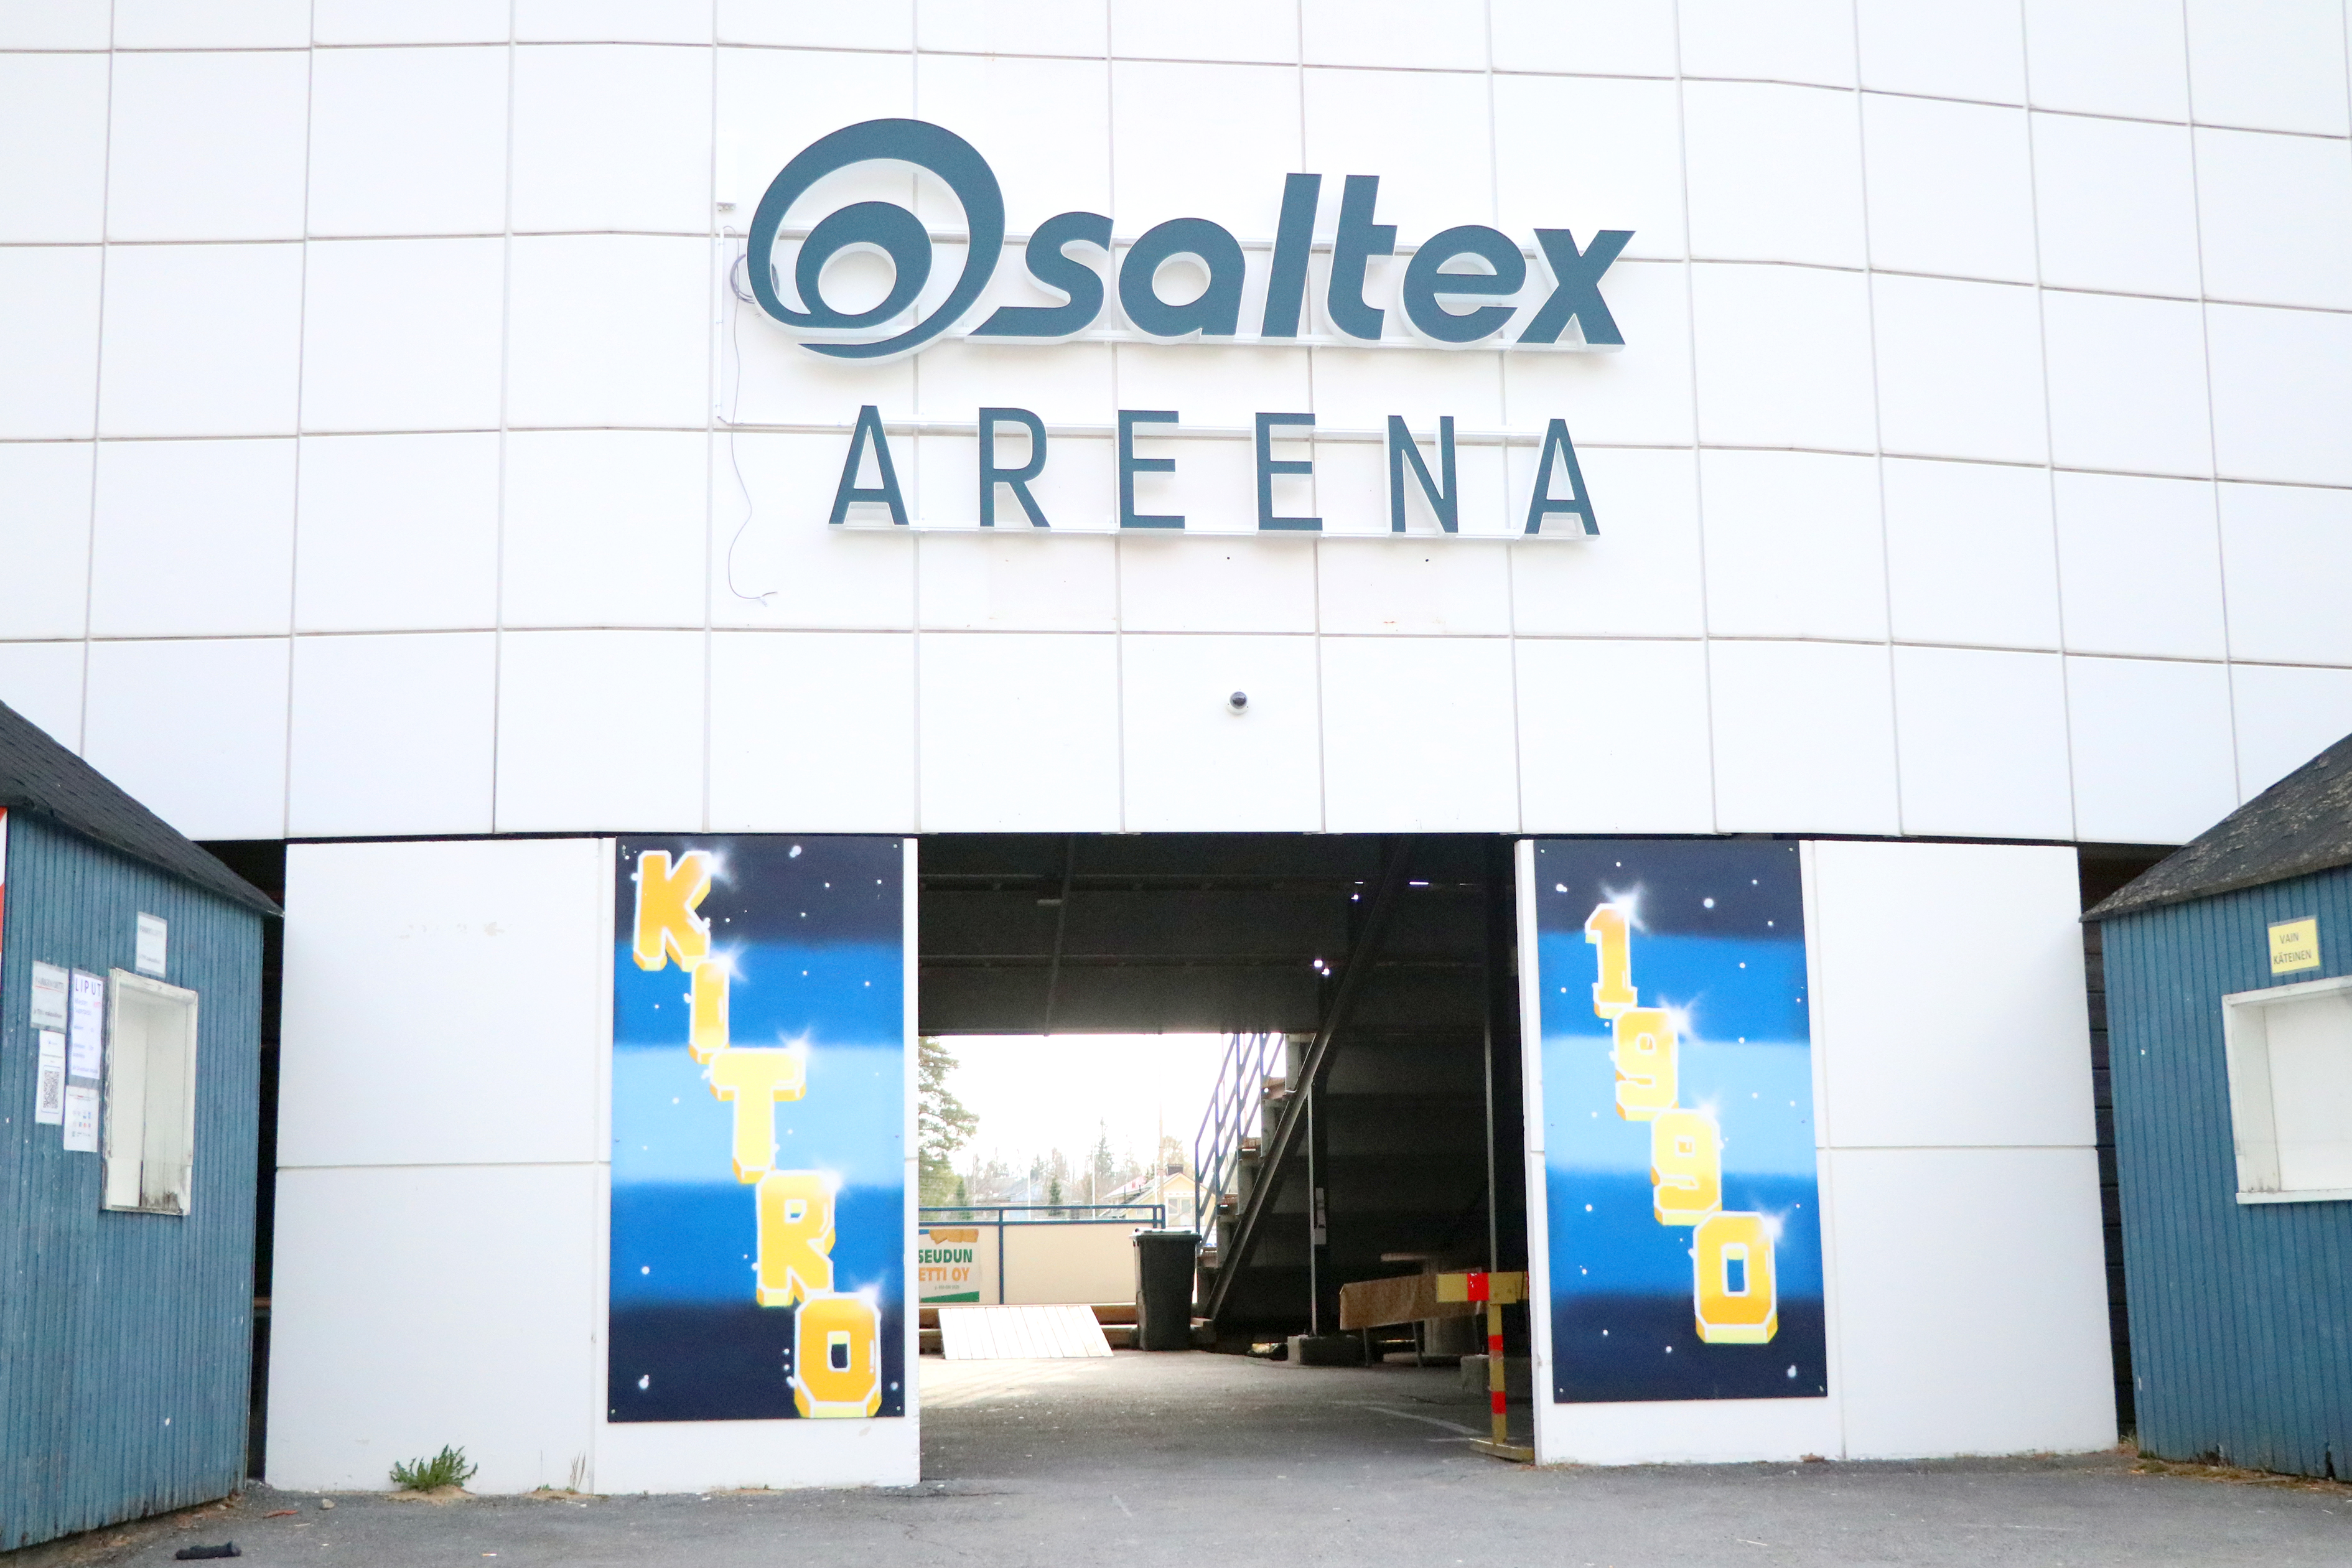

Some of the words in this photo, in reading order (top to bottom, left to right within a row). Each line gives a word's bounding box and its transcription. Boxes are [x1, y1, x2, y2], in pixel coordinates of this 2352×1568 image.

[962, 172, 1636, 346] saltex
[828, 404, 1599, 535] AREENA
[2273, 949, 2312, 964] KÄTEINEN
[2279, 932, 2299, 944] VAIN
[75, 978, 101, 996] LIPUT
[633, 850, 882, 1418] KITRO
[1584, 903, 1778, 1344] 1990
[951, 1267, 970, 1282] OY
